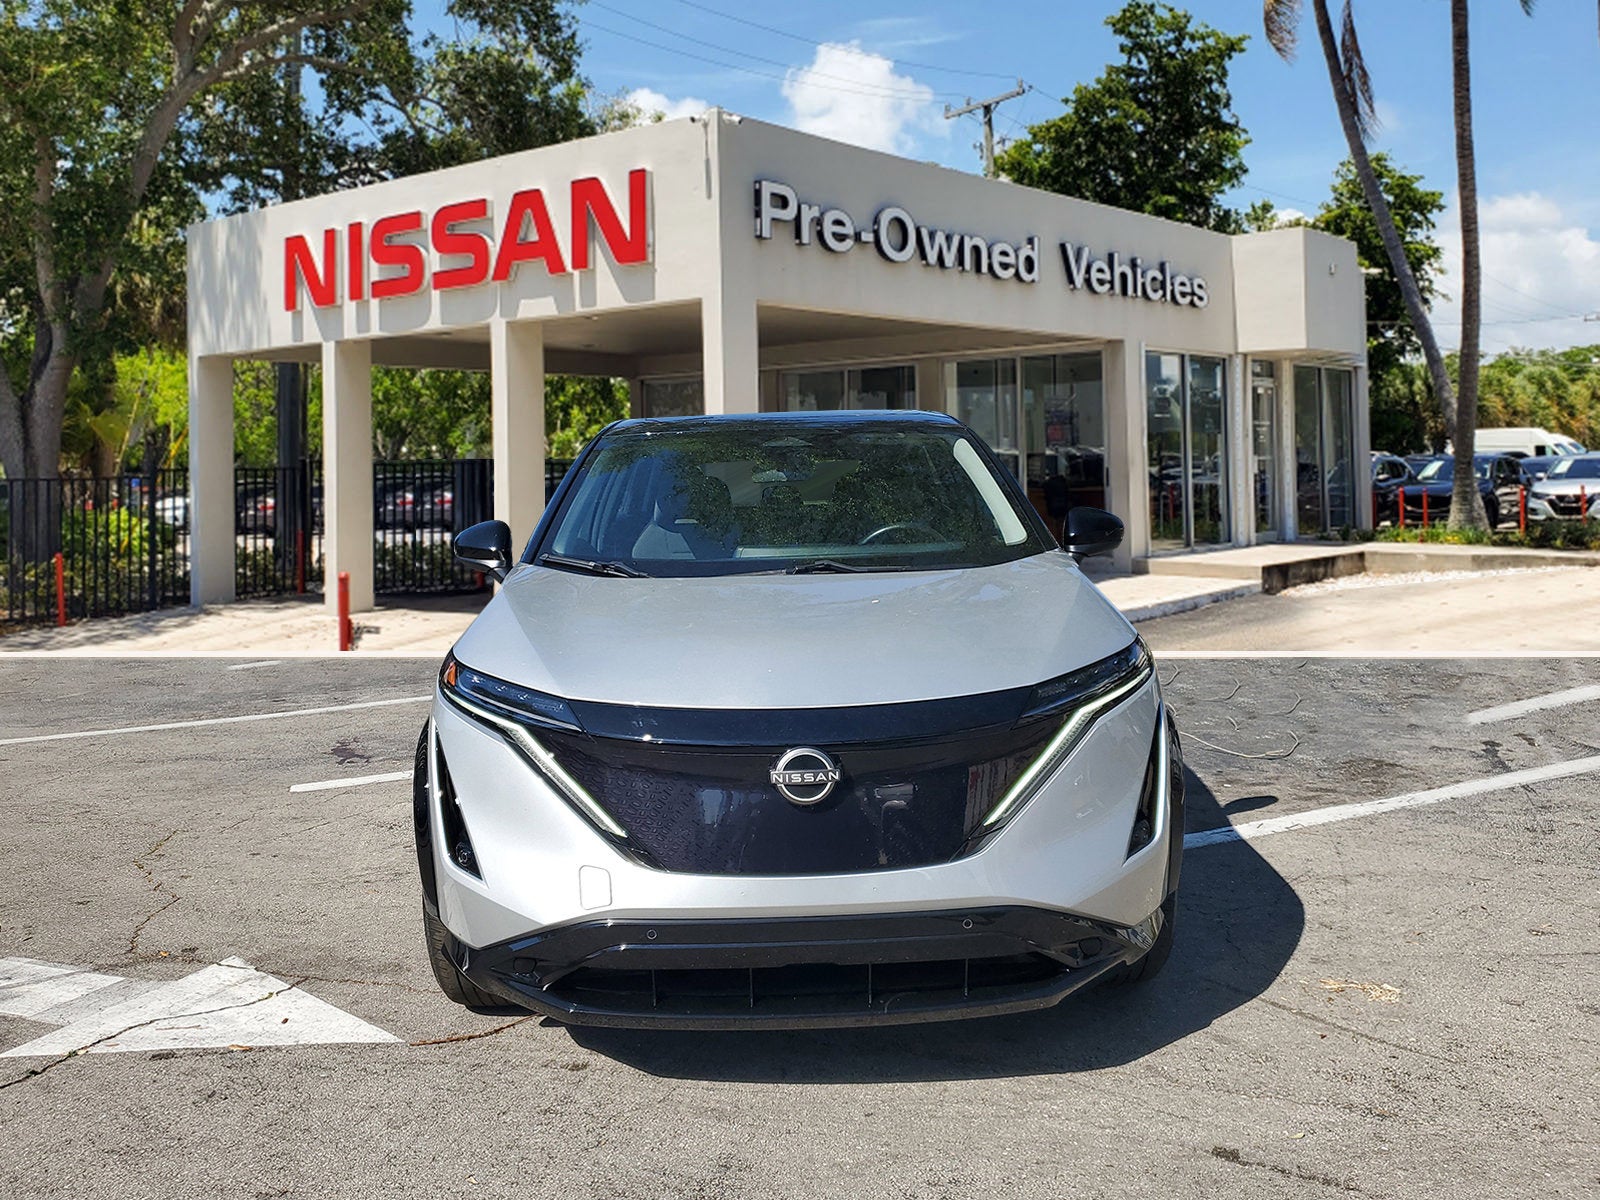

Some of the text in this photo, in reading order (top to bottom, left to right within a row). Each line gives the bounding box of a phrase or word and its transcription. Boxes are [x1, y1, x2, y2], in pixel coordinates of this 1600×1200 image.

[285, 168, 647, 312] NISSAN
[754, 179, 1209, 308] Pre-Owned Vehicles
[772, 771, 839, 783] NISSAN
